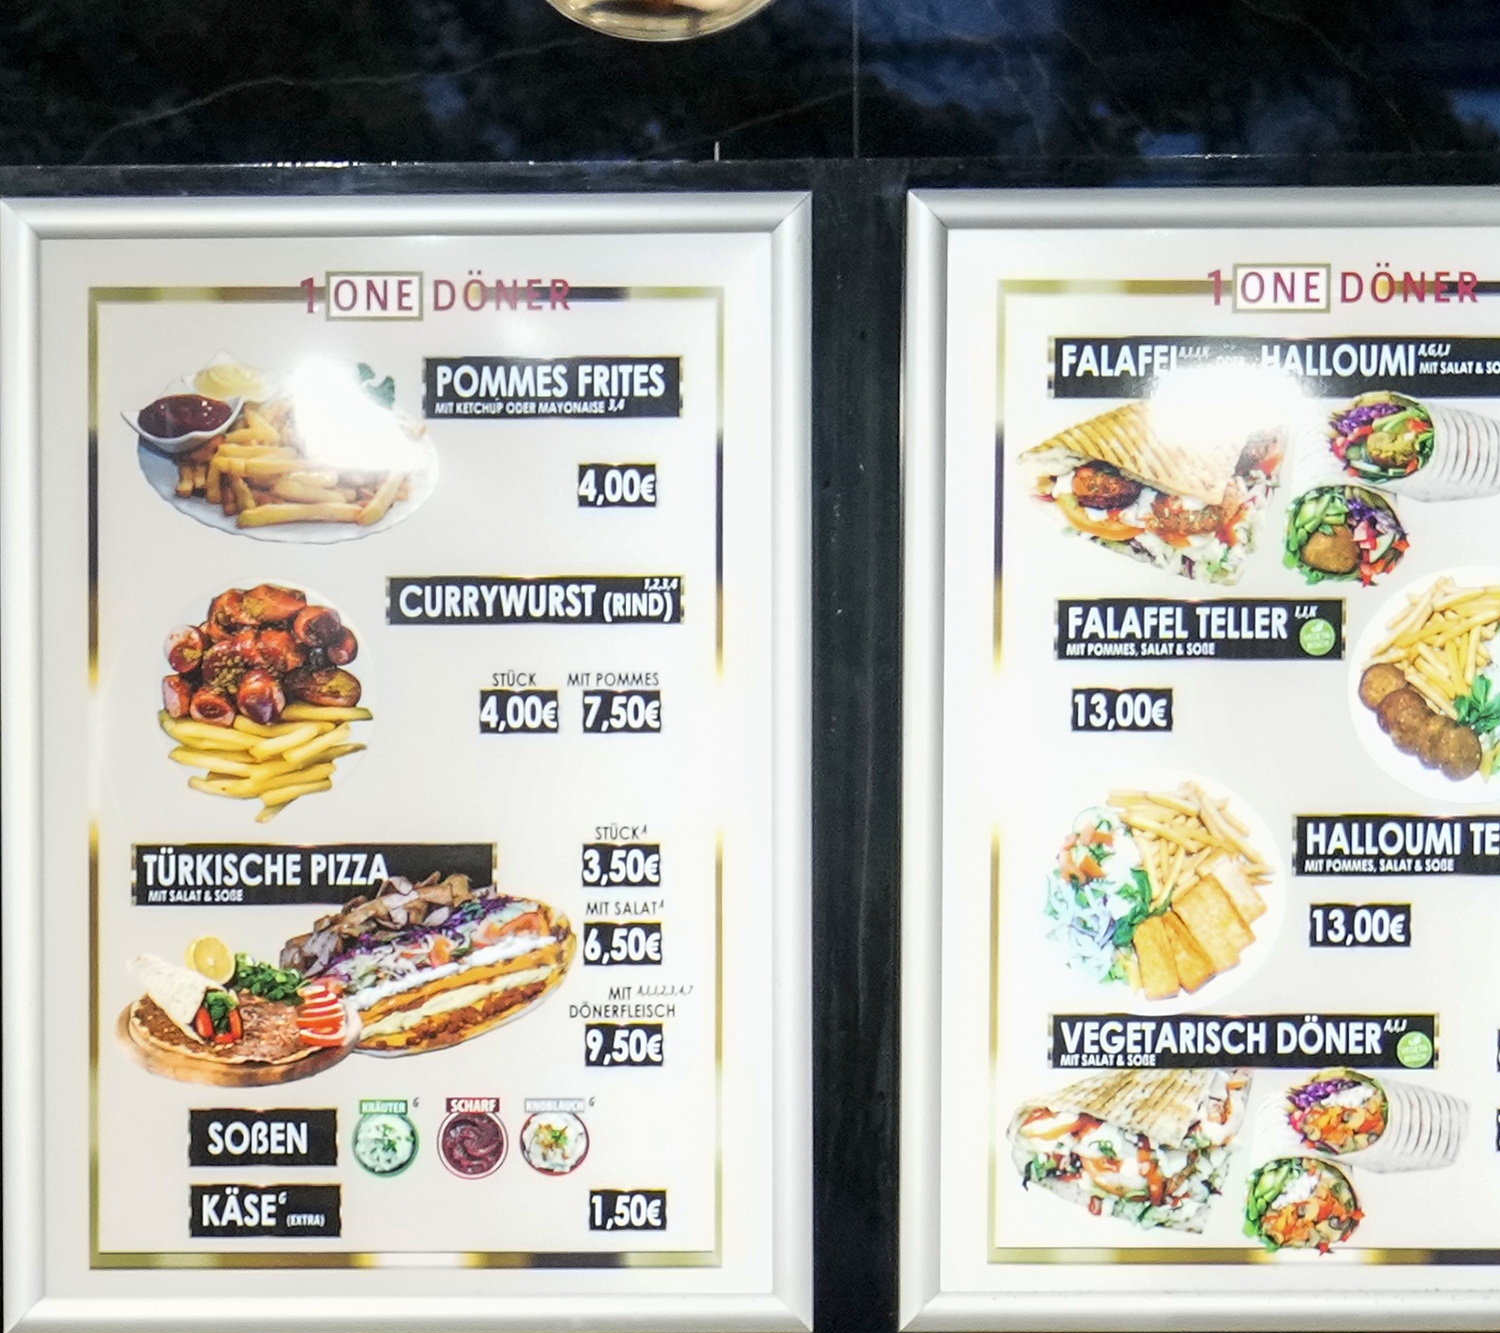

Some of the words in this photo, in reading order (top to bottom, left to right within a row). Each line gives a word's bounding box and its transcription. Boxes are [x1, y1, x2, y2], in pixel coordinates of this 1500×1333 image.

[333, 282, 414, 312] ONE
[433, 269, 570, 312] DÖNER
[1242, 274, 1321, 302] ONE
[1341, 261, 1477, 305] DÖNER
[435, 364, 570, 399] POMMES
[579, 364, 665, 397] FRITES
[579, 469, 655, 505] 4,00€
[400, 584, 596, 617] CURRYWURST
[604, 592, 672, 622] (RIND)
[1068, 605, 1188, 639] FALAFEL
[1196, 607, 1287, 639] TELLER
[492, 670, 538, 689] STÜCK
[567, 673, 590, 686] MIT
[597, 673, 658, 686] POMMES
[481, 696, 557, 730] 4,00€
[584, 696, 659, 730] 7,50€
[1075, 695, 1166, 730] 13,00€
[594, 823, 640, 841] STÜCK
[1307, 822, 1461, 855] HALLOUMI
[143, 847, 301, 886] TÜRKISCHE
[310, 854, 388, 886] PIZZA
[584, 849, 659, 884] 3,50€
[586, 902, 609, 914] MIT
[615, 902, 656, 915] SALAT
[1313, 909, 1405, 945] 13,00€
[585, 928, 660, 963] 6,50€
[568, 999, 677, 1020] DÖNERFLEISCH
[609, 987, 631, 1000] MIT
[587, 1029, 662, 1064] 9,50€
[1061, 1021, 1266, 1054] VEGETARISCH
[1277, 1015, 1381, 1054] DÖNER
[450, 1097, 498, 1115] SCHARF
[203, 1187, 276, 1226] KÄSE
[592, 1195, 661, 1229] 1,50€
